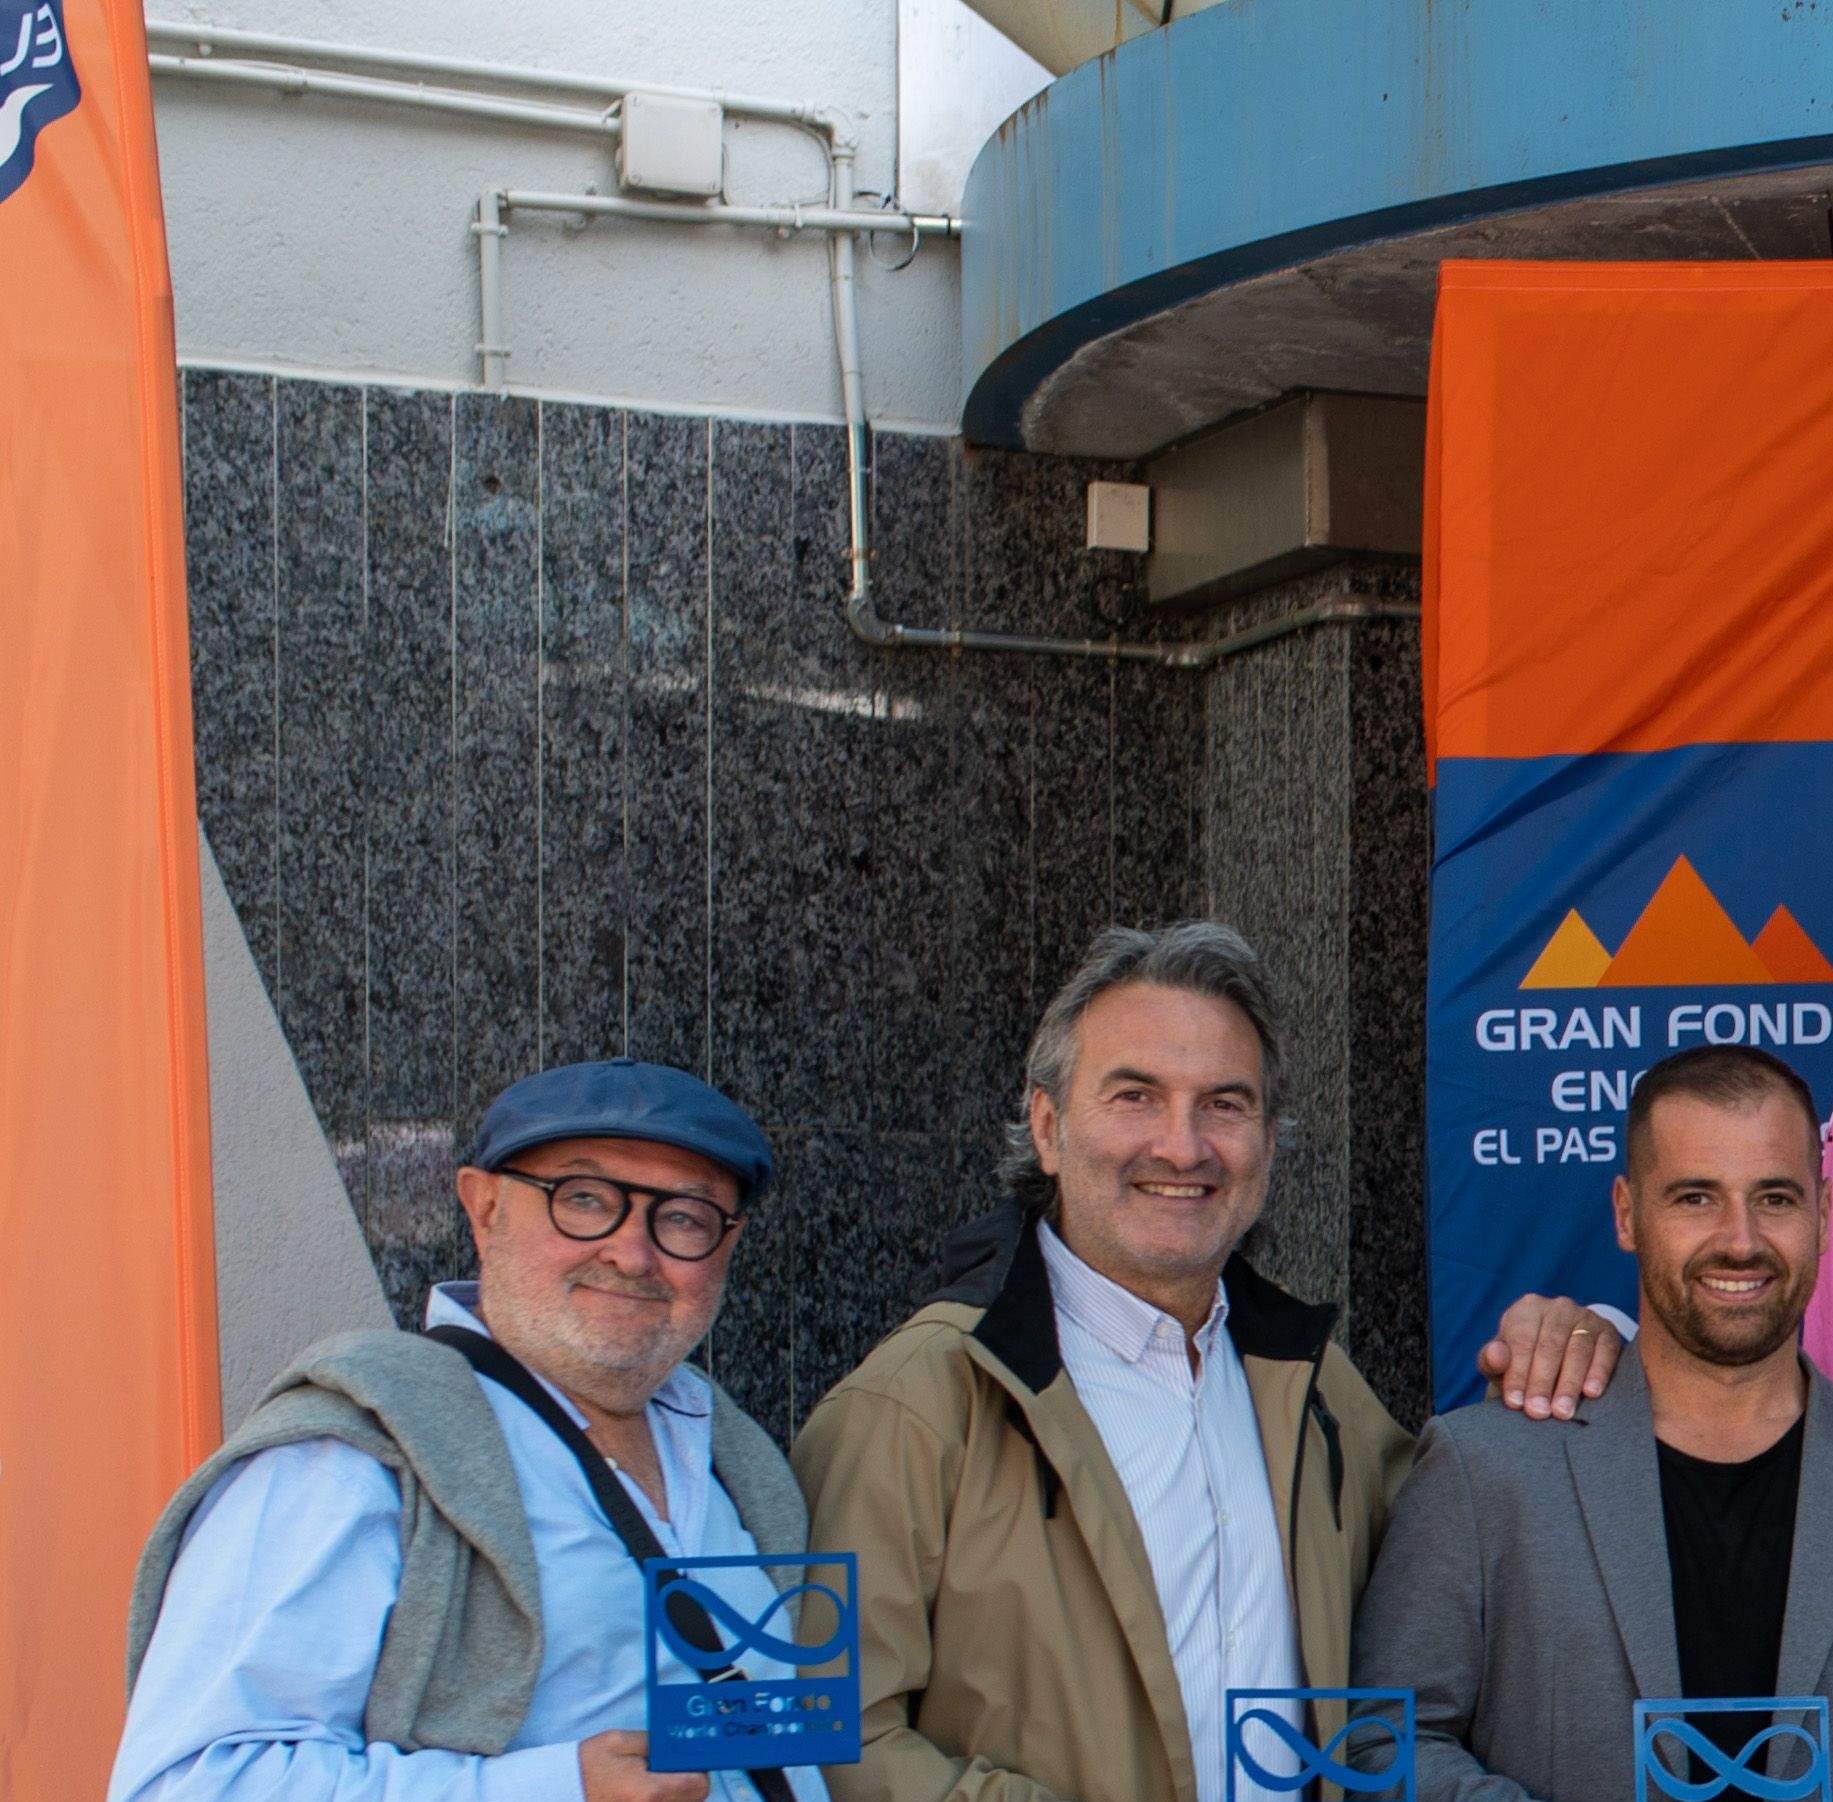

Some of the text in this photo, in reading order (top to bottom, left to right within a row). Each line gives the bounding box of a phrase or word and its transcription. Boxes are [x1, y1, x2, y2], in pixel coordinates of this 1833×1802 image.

[1475, 1006, 1642, 1051] GRAN
[1473, 1126, 1616, 1165] EL PAS
